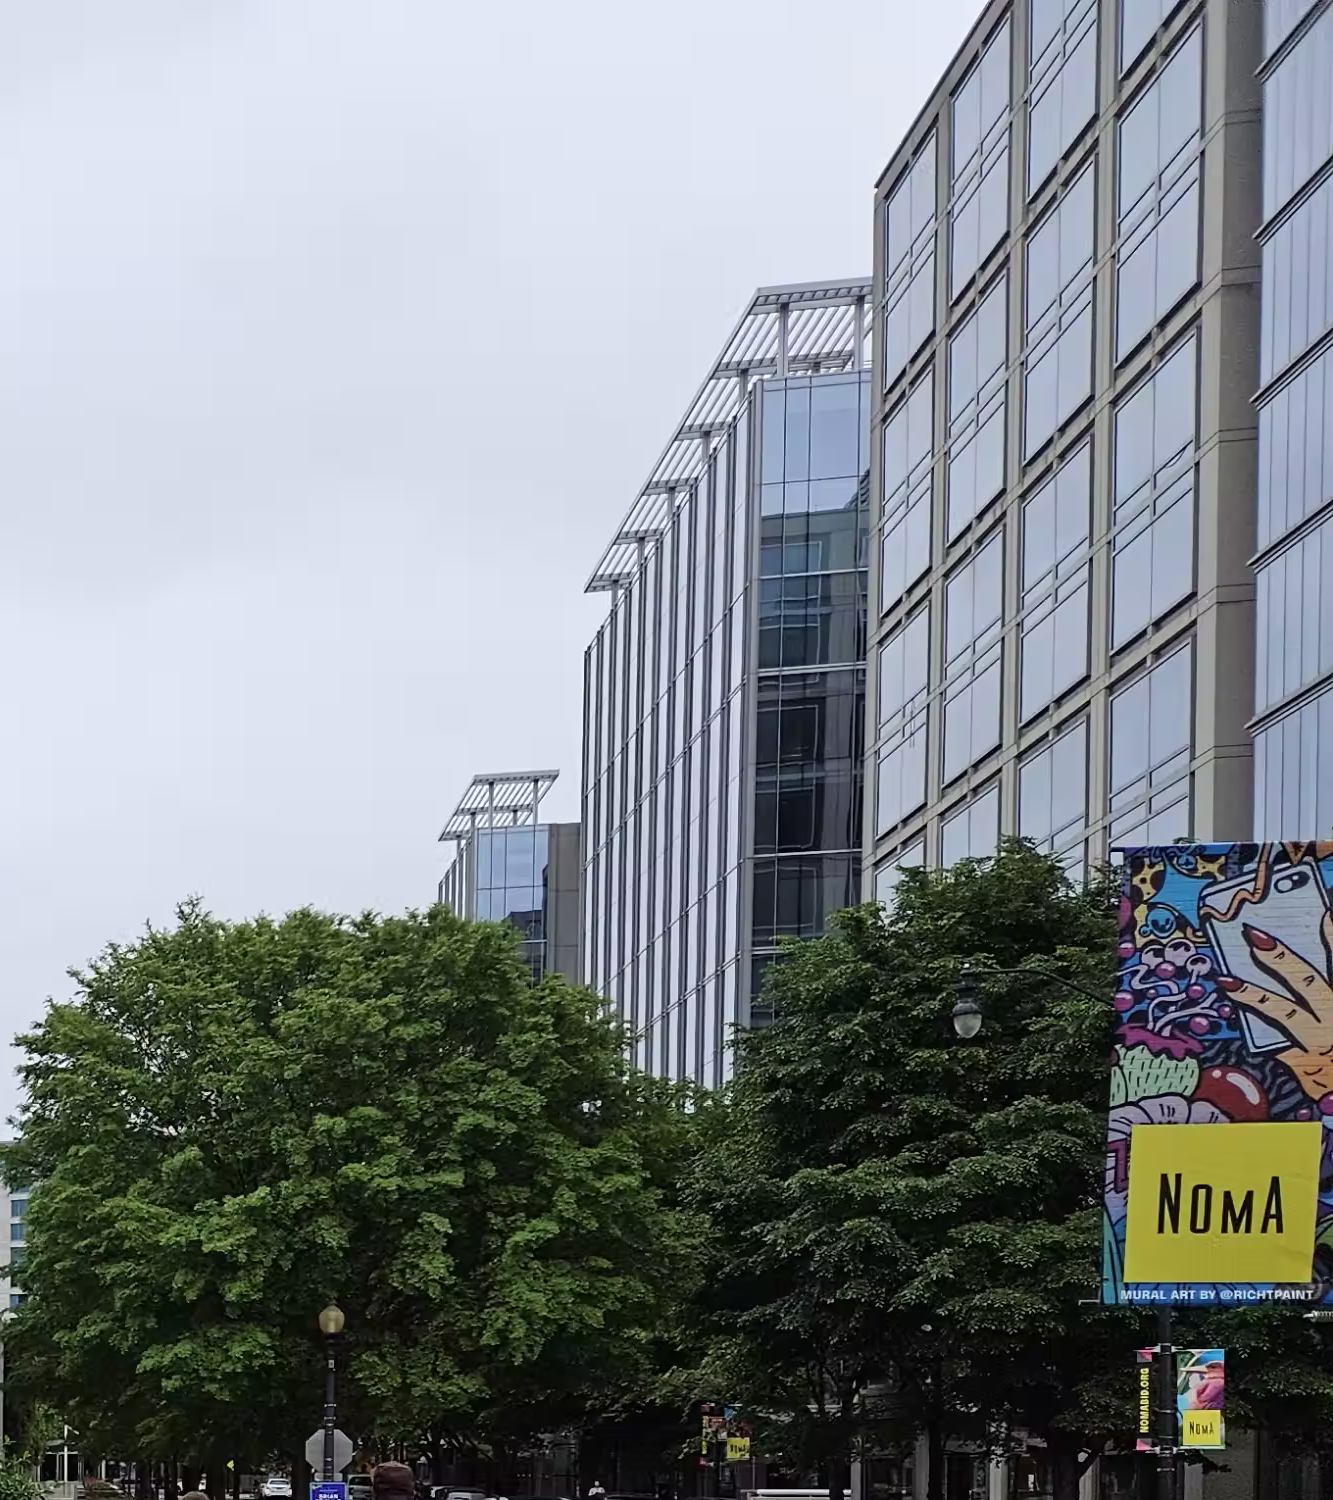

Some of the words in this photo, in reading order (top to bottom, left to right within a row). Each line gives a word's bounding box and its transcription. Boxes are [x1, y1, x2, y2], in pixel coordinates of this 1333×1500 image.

[1120, 1289, 1167, 1300] MURAL
[1171, 1289, 1196, 1300] ART
[1199, 1289, 1217, 1300] BY
[1220, 1289, 1314, 1300] @RICHTPAINT
[1140, 1367, 1149, 1433] NOMABID.ORG
